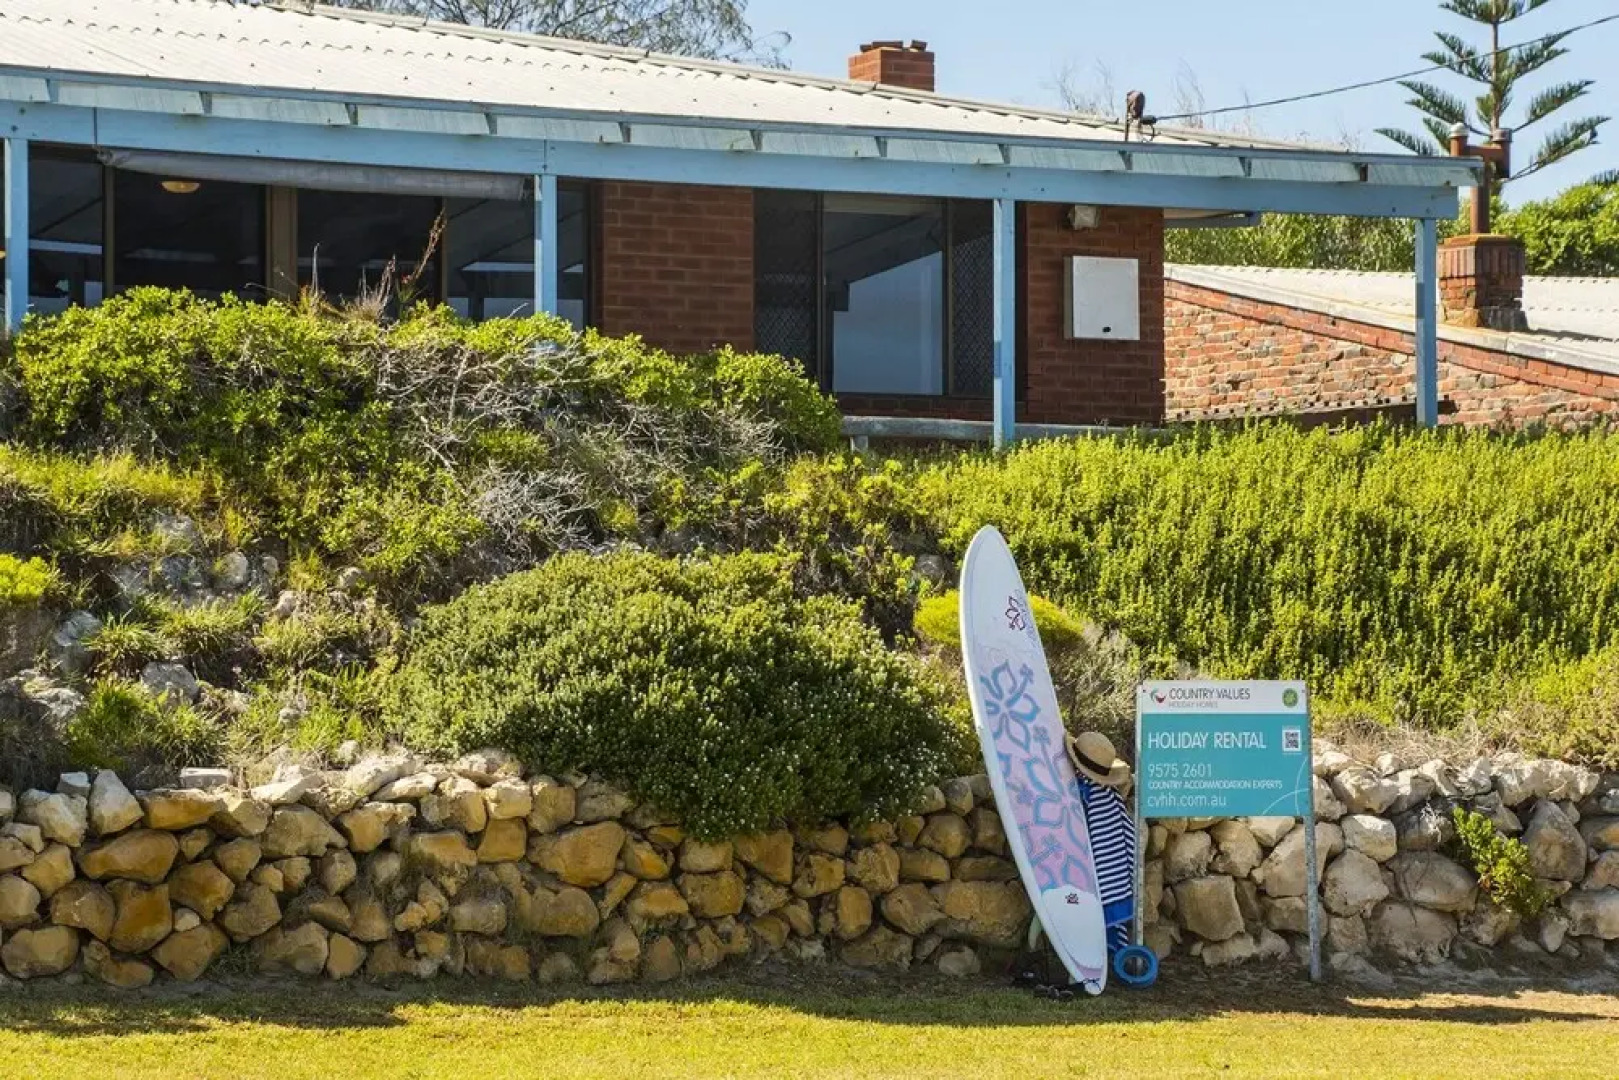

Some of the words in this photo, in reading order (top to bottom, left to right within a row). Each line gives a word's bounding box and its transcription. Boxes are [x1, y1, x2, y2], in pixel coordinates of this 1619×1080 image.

[1169, 688, 1214, 700] COUNTRY
[1215, 688, 1250, 700] VALUES
[1148, 732, 1208, 749] HOLIDAY
[1214, 732, 1266, 749] RENTAL
[1148, 763, 1178, 778] 9575
[1182, 763, 1212, 778] 2601
[1148, 780, 1182, 790] COUNTRY
[1183, 780, 1251, 790] ACCOMMODATION
[1252, 780, 1283, 790] EXPERTS
[1147, 792, 1226, 807] cvhh.com.au
